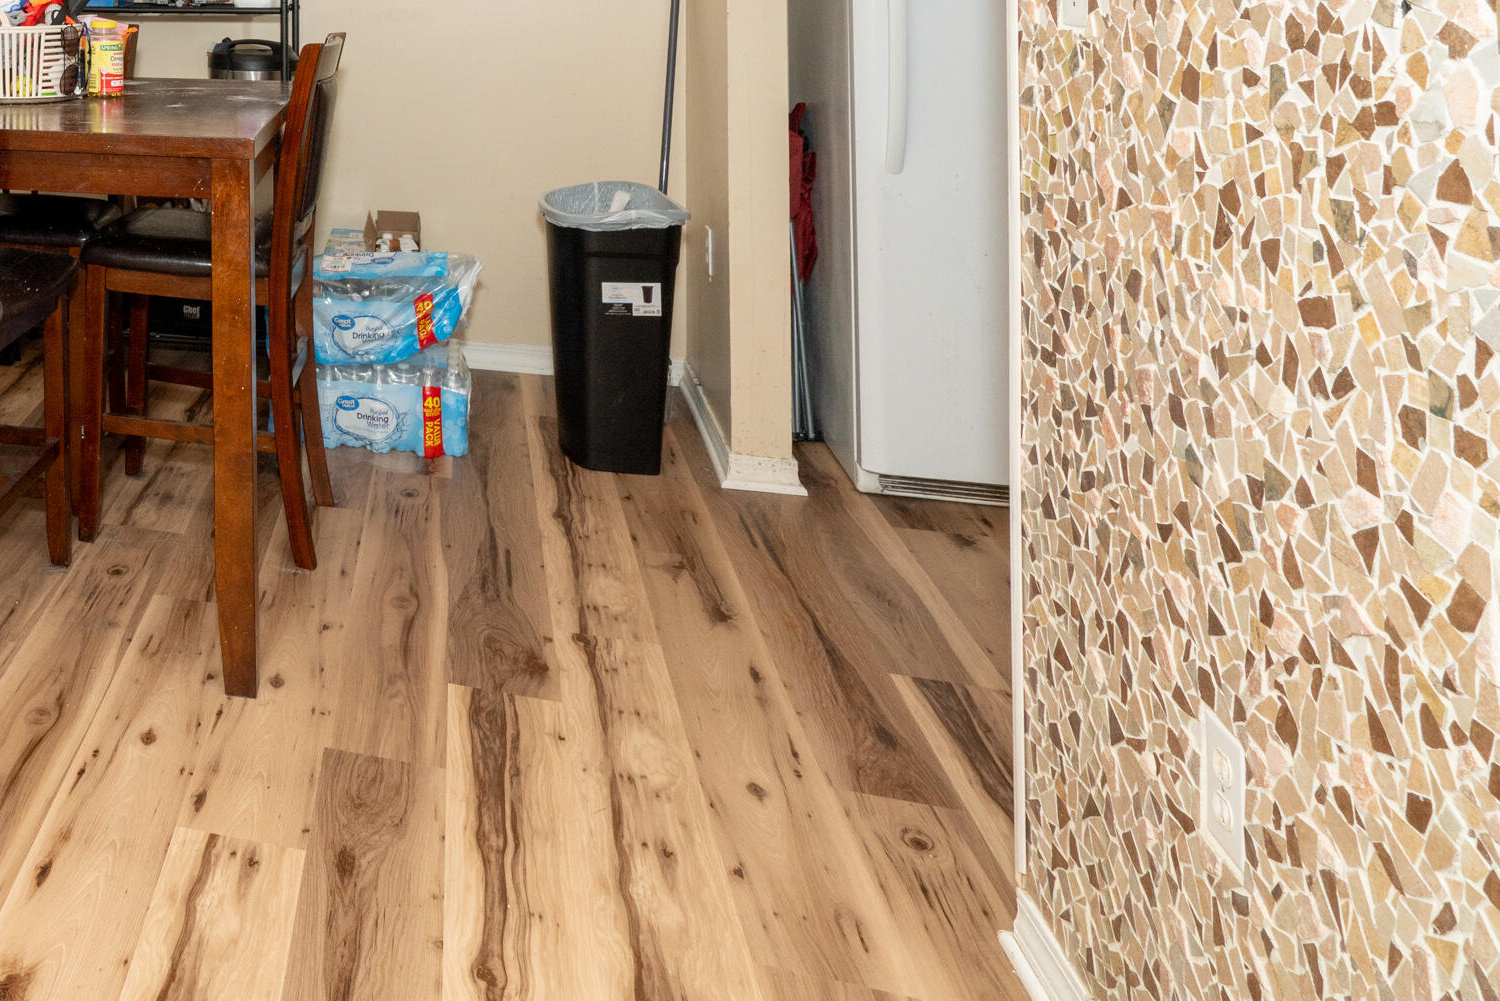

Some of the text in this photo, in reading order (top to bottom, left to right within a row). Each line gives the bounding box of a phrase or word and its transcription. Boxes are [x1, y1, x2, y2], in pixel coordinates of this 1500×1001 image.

[183, 304, 201, 314] Chef
[416, 300, 434, 311] 40
[352, 330, 386, 341] Drinking
[424, 396, 441, 409] 40
[356, 412, 390, 423] Drinking
[425, 421, 434, 447] PACK
[433, 418, 441, 447] VALUE
